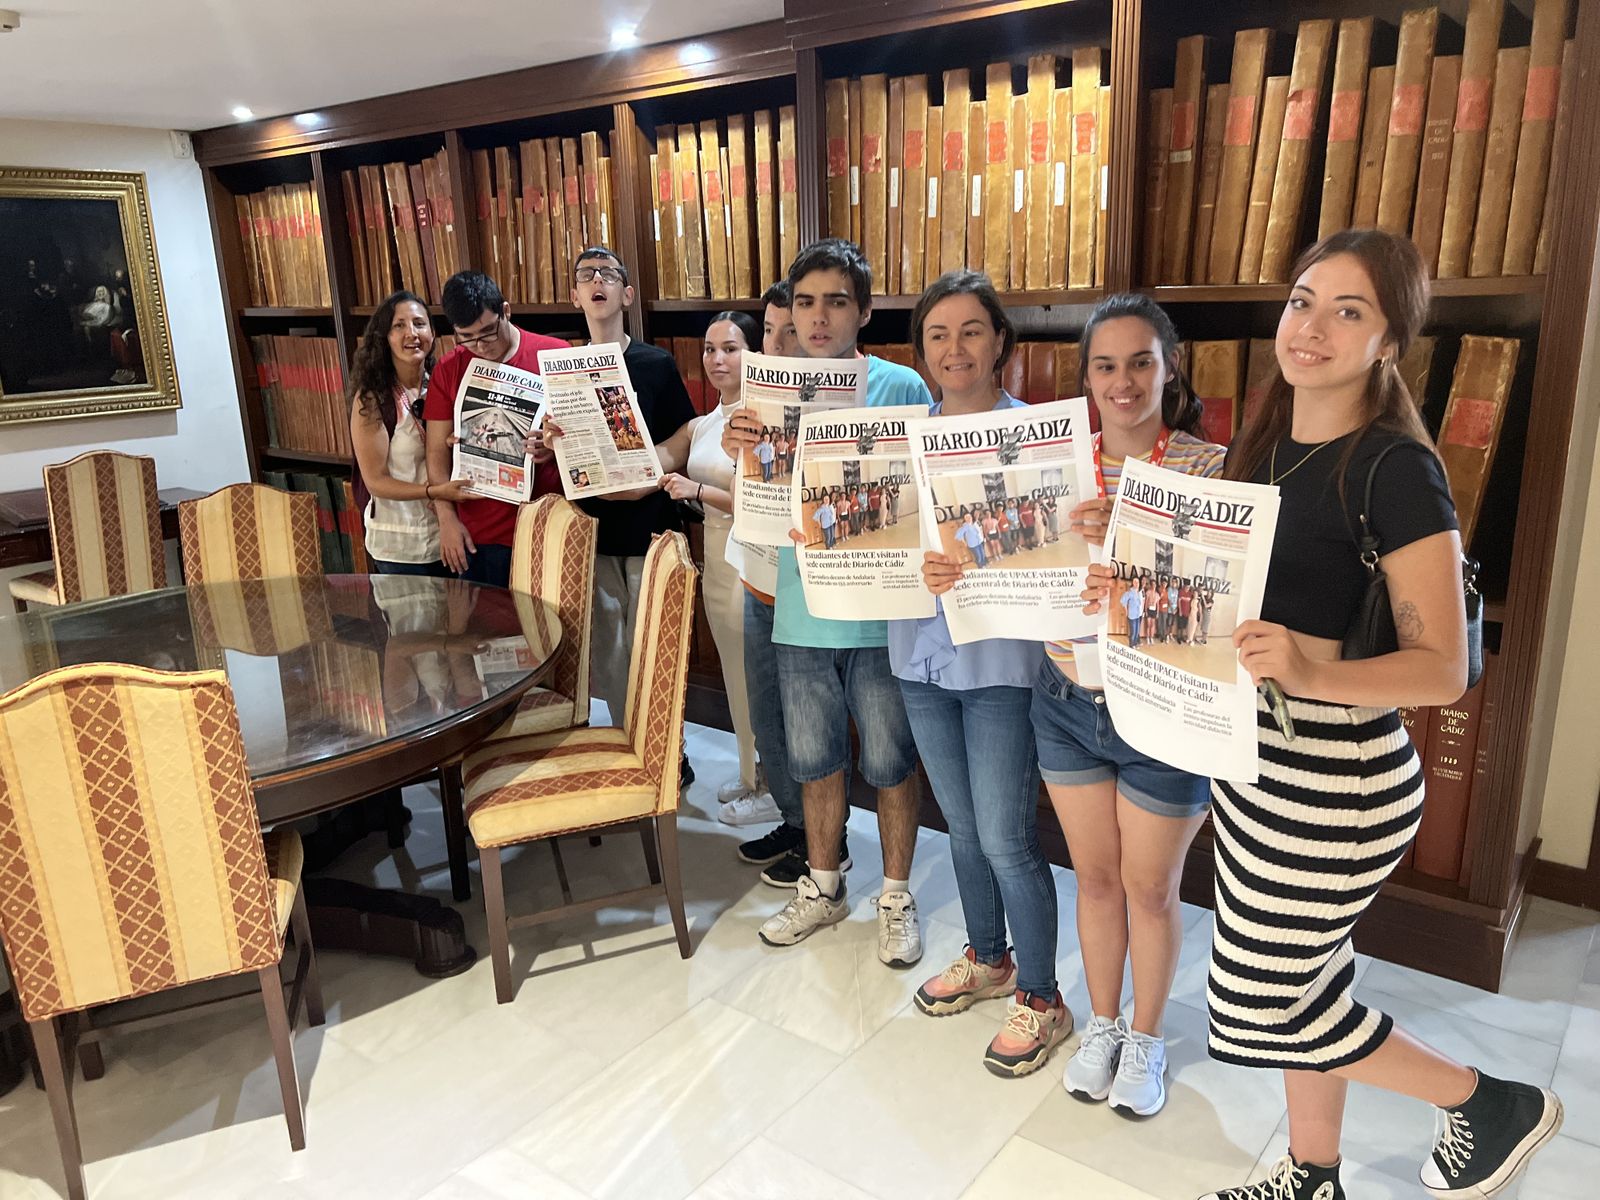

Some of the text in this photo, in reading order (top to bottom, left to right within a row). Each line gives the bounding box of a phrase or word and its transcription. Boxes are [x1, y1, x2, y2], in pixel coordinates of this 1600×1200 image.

[544, 354, 617, 372] DIARIO DE CADIZ
[474, 366, 544, 391] DIARIO DE CADI
[746, 365, 790, 385] DIARIO
[814, 372, 858, 386] CADIZ
[805, 424, 848, 441] DIARIO
[872, 421, 908, 437] CADI
[921, 430, 982, 452] DIARIO
[1014, 418, 1072, 443] CADIZ
[1122, 477, 1164, 509] DIARIO
[1190, 498, 1254, 526] CADIZ
[973, 580, 1000, 589] central
[1002, 580, 1011, 588] de
[1012, 580, 1038, 588] Diario
[1039, 580, 1049, 588] de
[1050, 579, 1074, 588] Cádiz
[1010, 571, 1039, 579] UPACE
[1039, 570, 1068, 579] visitan
[1069, 569, 1078, 577] la
[1107, 641, 1219, 693] Estudiantes de UPACE visitan la
[1107, 654, 1214, 704] sede central de Diario de Cádiz
[1440, 708, 1469, 720] DIARIO
[1448, 717, 1458, 726] DE
[1440, 725, 1465, 736] CADIZ
